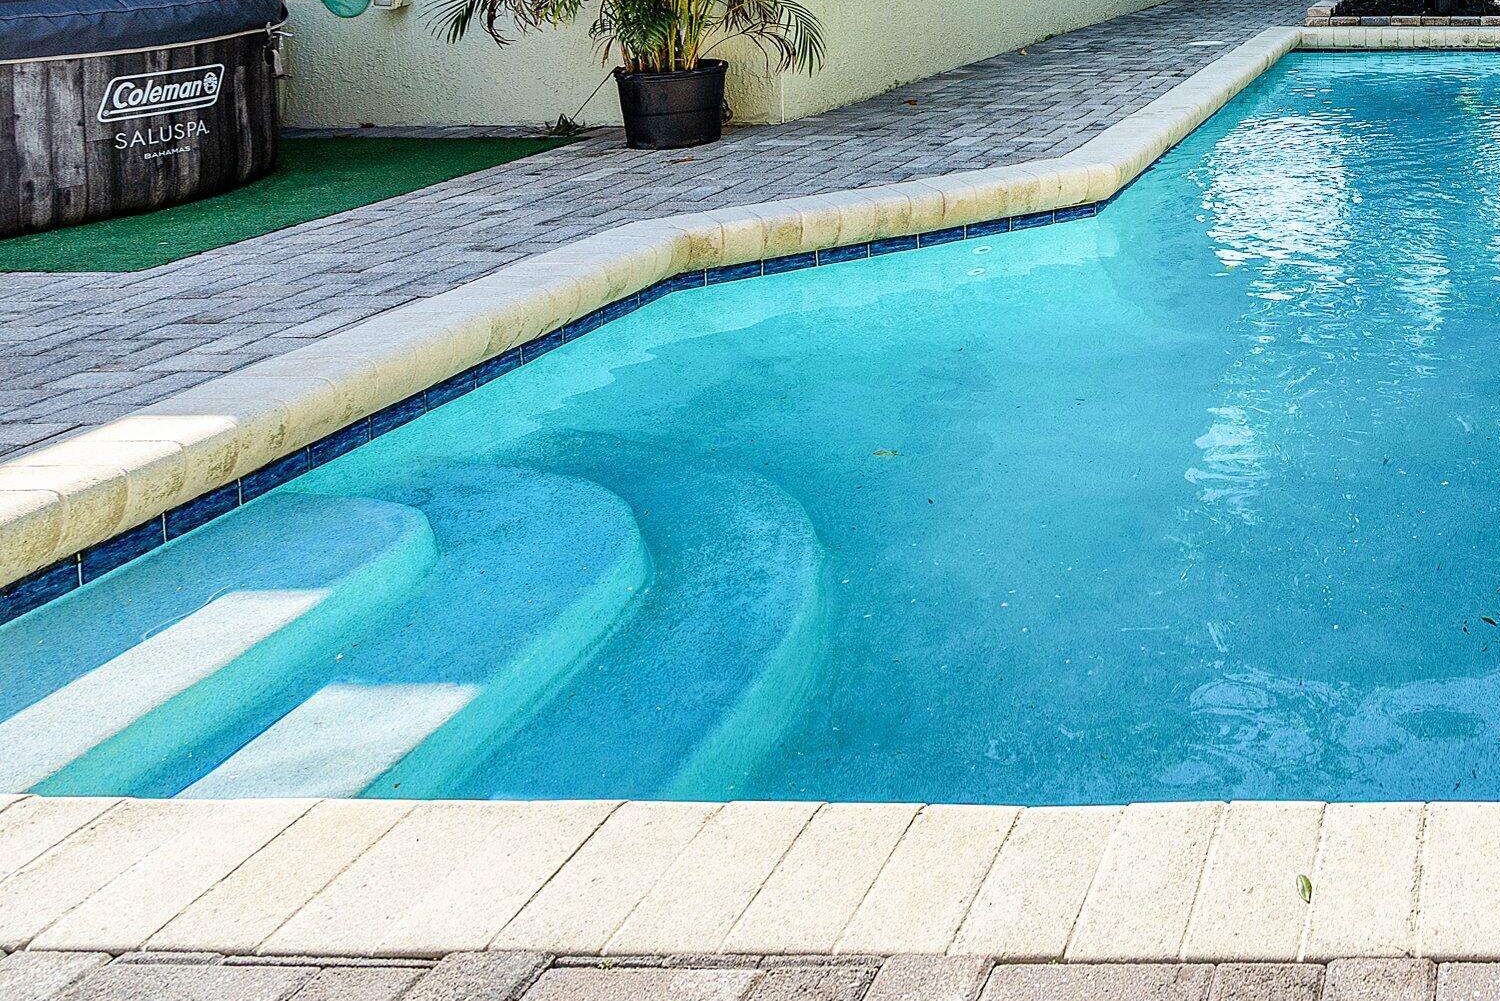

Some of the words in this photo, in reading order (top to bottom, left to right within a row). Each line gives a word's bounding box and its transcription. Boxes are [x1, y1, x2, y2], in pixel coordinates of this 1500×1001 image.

[113, 80, 202, 109] Coleman
[114, 120, 208, 149] SALUSPA
[144, 146, 191, 159] BAHAMAS
